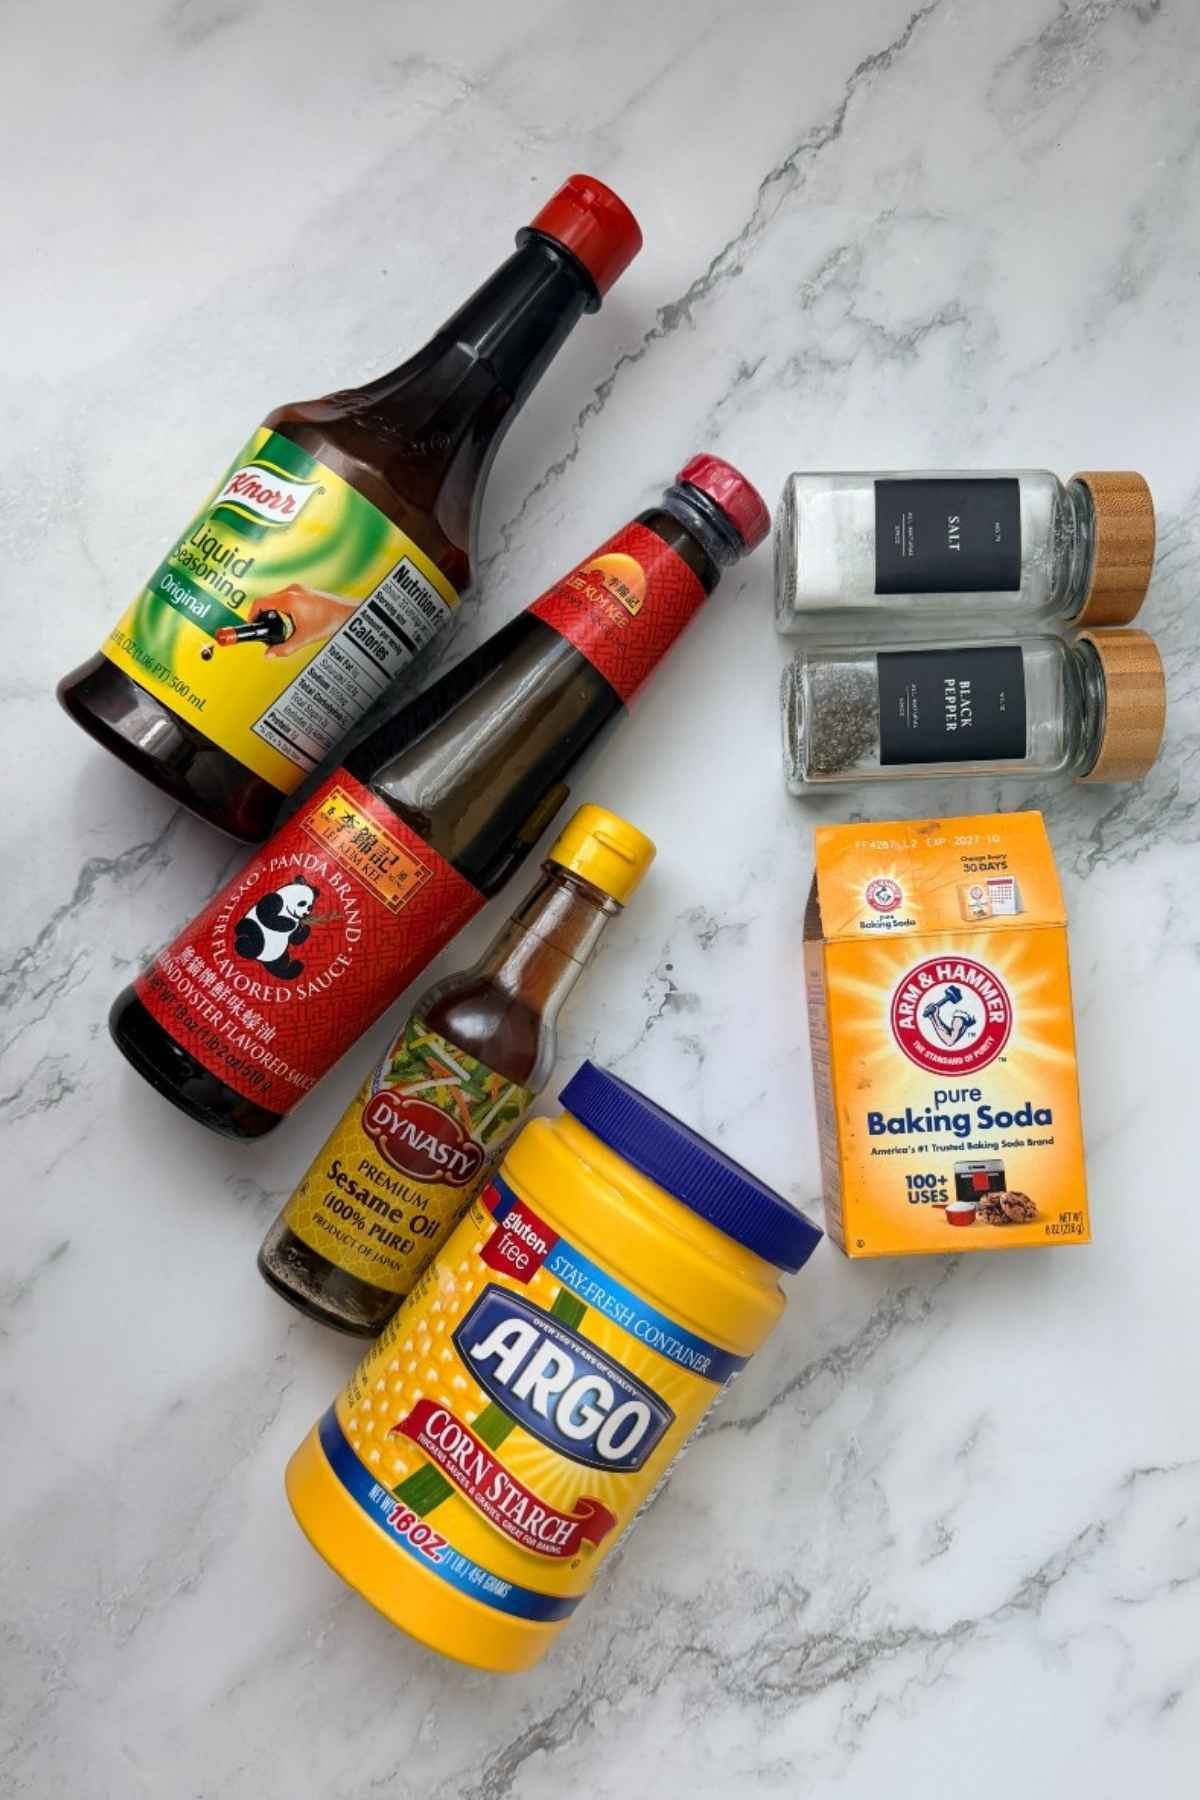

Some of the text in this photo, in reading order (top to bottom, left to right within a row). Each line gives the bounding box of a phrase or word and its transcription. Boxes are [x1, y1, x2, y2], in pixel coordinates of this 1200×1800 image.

[223, 472, 297, 514] Knorr
[189, 523, 255, 578] Liquid
[947, 515, 961, 552] SALT
[160, 573, 212, 619] Original
[172, 542, 247, 609] Seasoning
[392, 564, 438, 620] Nutrition
[584, 585, 610, 609] KUM
[604, 604, 630, 629] KEE
[326, 644, 354, 672] Total Fat
[347, 616, 392, 661] Calories
[168, 673, 190, 697] 500
[187, 694, 208, 712] mL
[943, 679, 958, 731] PEPPER
[959, 681, 973, 728] BLACK
[267, 710, 292, 735] Protein
[336, 809, 400, 874] 李錦記
[361, 864, 382, 885] KEE
[963, 861, 1009, 873] 30 DAYS
[270, 852, 362, 943] PANDA BRAND
[860, 918, 917, 930] Baking Soda
[211, 940, 292, 1003] FLAVORED
[296, 952, 353, 1001] SAUCE
[898, 963, 1005, 1029] ARM & HAMMER
[177, 977, 224, 1027] OYSTER
[219, 1019, 289, 1075] FLAVORED
[285, 1068, 317, 1091] SAUCE
[912, 1040, 926, 1055] THE
[973, 1035, 996, 1059] PURITY
[867, 1101, 1053, 1138] Baking Soda
[934, 1087, 982, 1110] pure
[371, 1103, 478, 1175] DYNASTY
[871, 1136, 1055, 1156] America's #1 Trusted Baking Soda Brand
[327, 1160, 404, 1224] Sesame
[409, 1214, 441, 1239] Oil
[358, 1158, 431, 1211] PREMIUM
[905, 1173, 949, 1189] 100+
[907, 1189, 949, 1204] USES
[311, 1211, 402, 1272] PRODUCT OF JAPAN
[322, 1190, 416, 1256] (100% PURE)
[501, 1210, 549, 1256] gluten-
[497, 1232, 531, 1271] free
[549, 1254, 712, 1375] STAY-FRESH CONTAINER
[532, 1317, 555, 1336] OVER
[569, 1342, 598, 1365] YEARS
[595, 1360, 609, 1372] OF
[606, 1369, 639, 1397] QUALITY
[469, 1318, 652, 1461] ARGO
[367, 1482, 385, 1505] NET
[424, 1409, 579, 1546] CORN STARCH
[445, 1458, 470, 1489] SAUCES
[468, 1486, 476, 1495] &
[501, 1518, 522, 1540] GREAT
[522, 1534, 537, 1548] FOR
[481, 1576, 513, 1599] GRAMS
